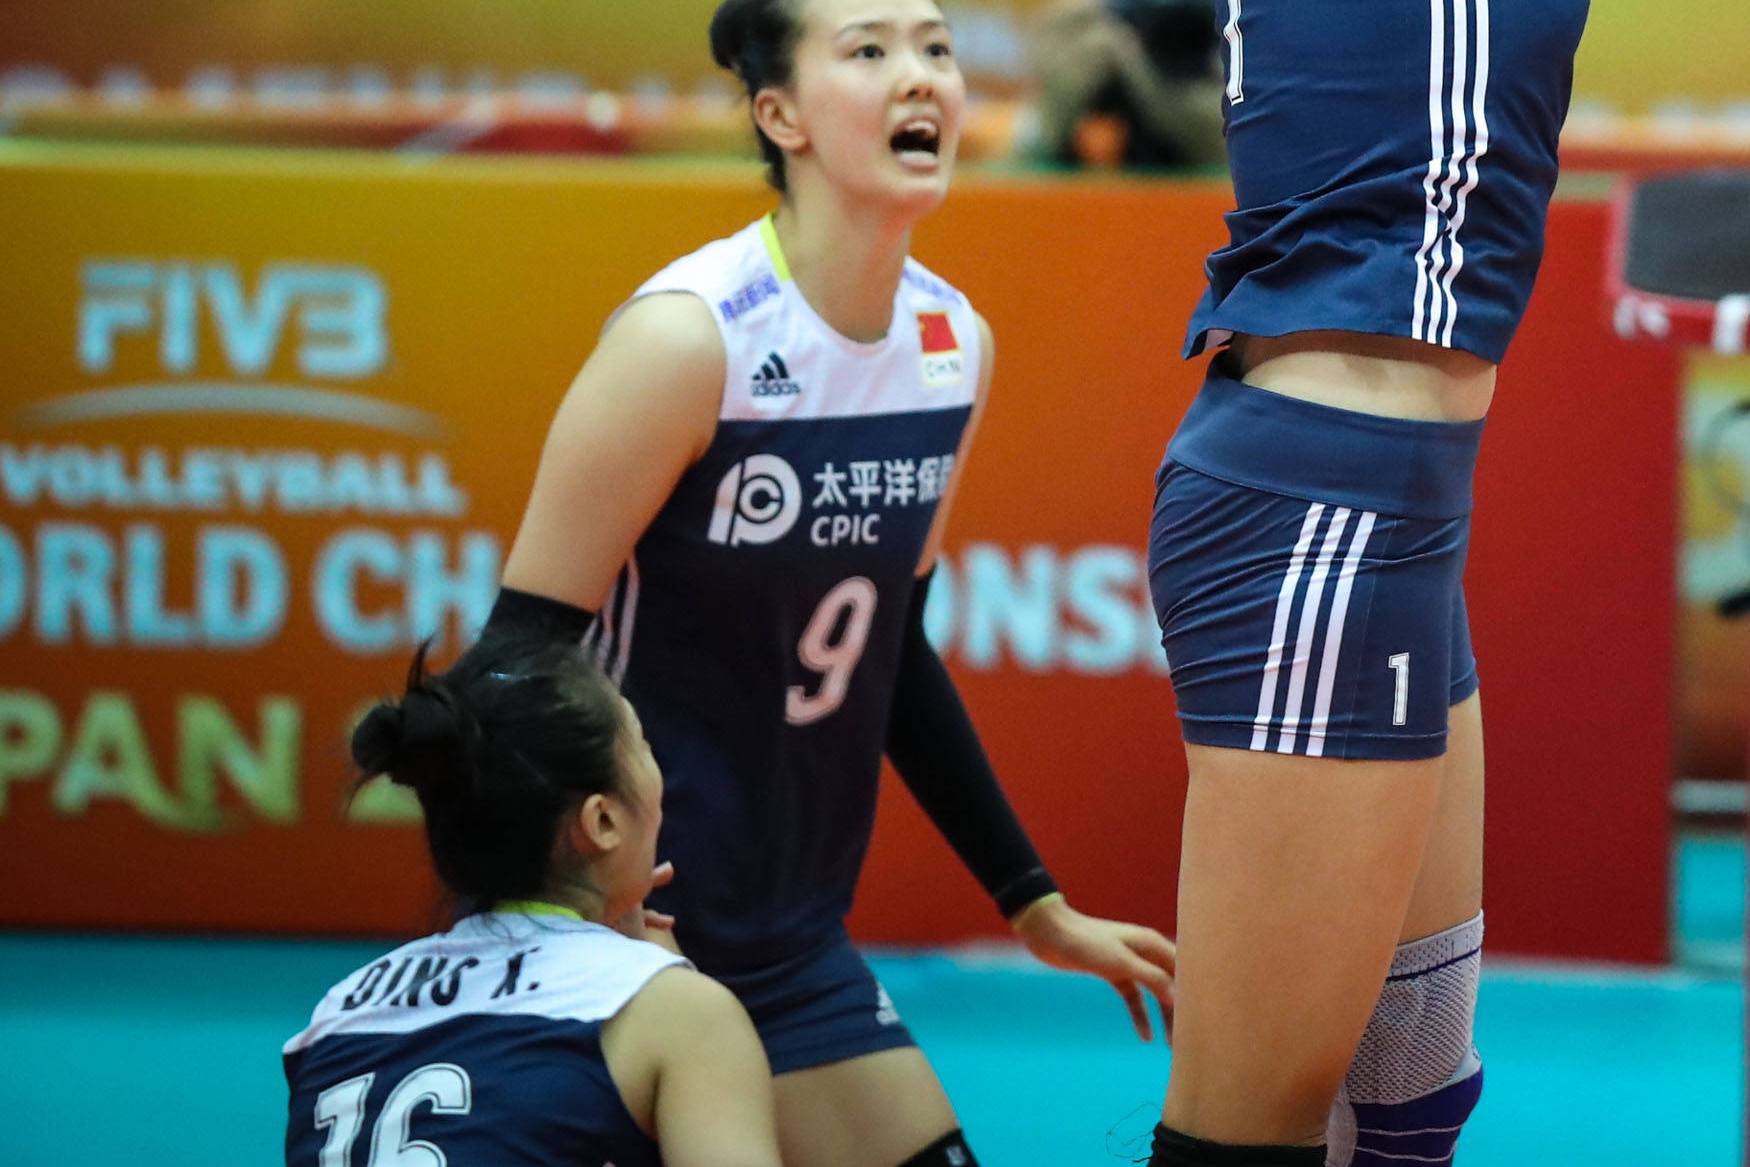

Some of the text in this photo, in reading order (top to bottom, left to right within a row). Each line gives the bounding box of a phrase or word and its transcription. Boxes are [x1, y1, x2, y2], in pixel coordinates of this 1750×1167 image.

[80, 257, 388, 377] FIVB
[0, 446, 466, 516] VOLLEYBALL
[810, 514, 880, 546] CPIC
[785, 575, 878, 726] 9
[1388, 652, 1410, 726] 1
[314, 1062, 473, 1167] 16
